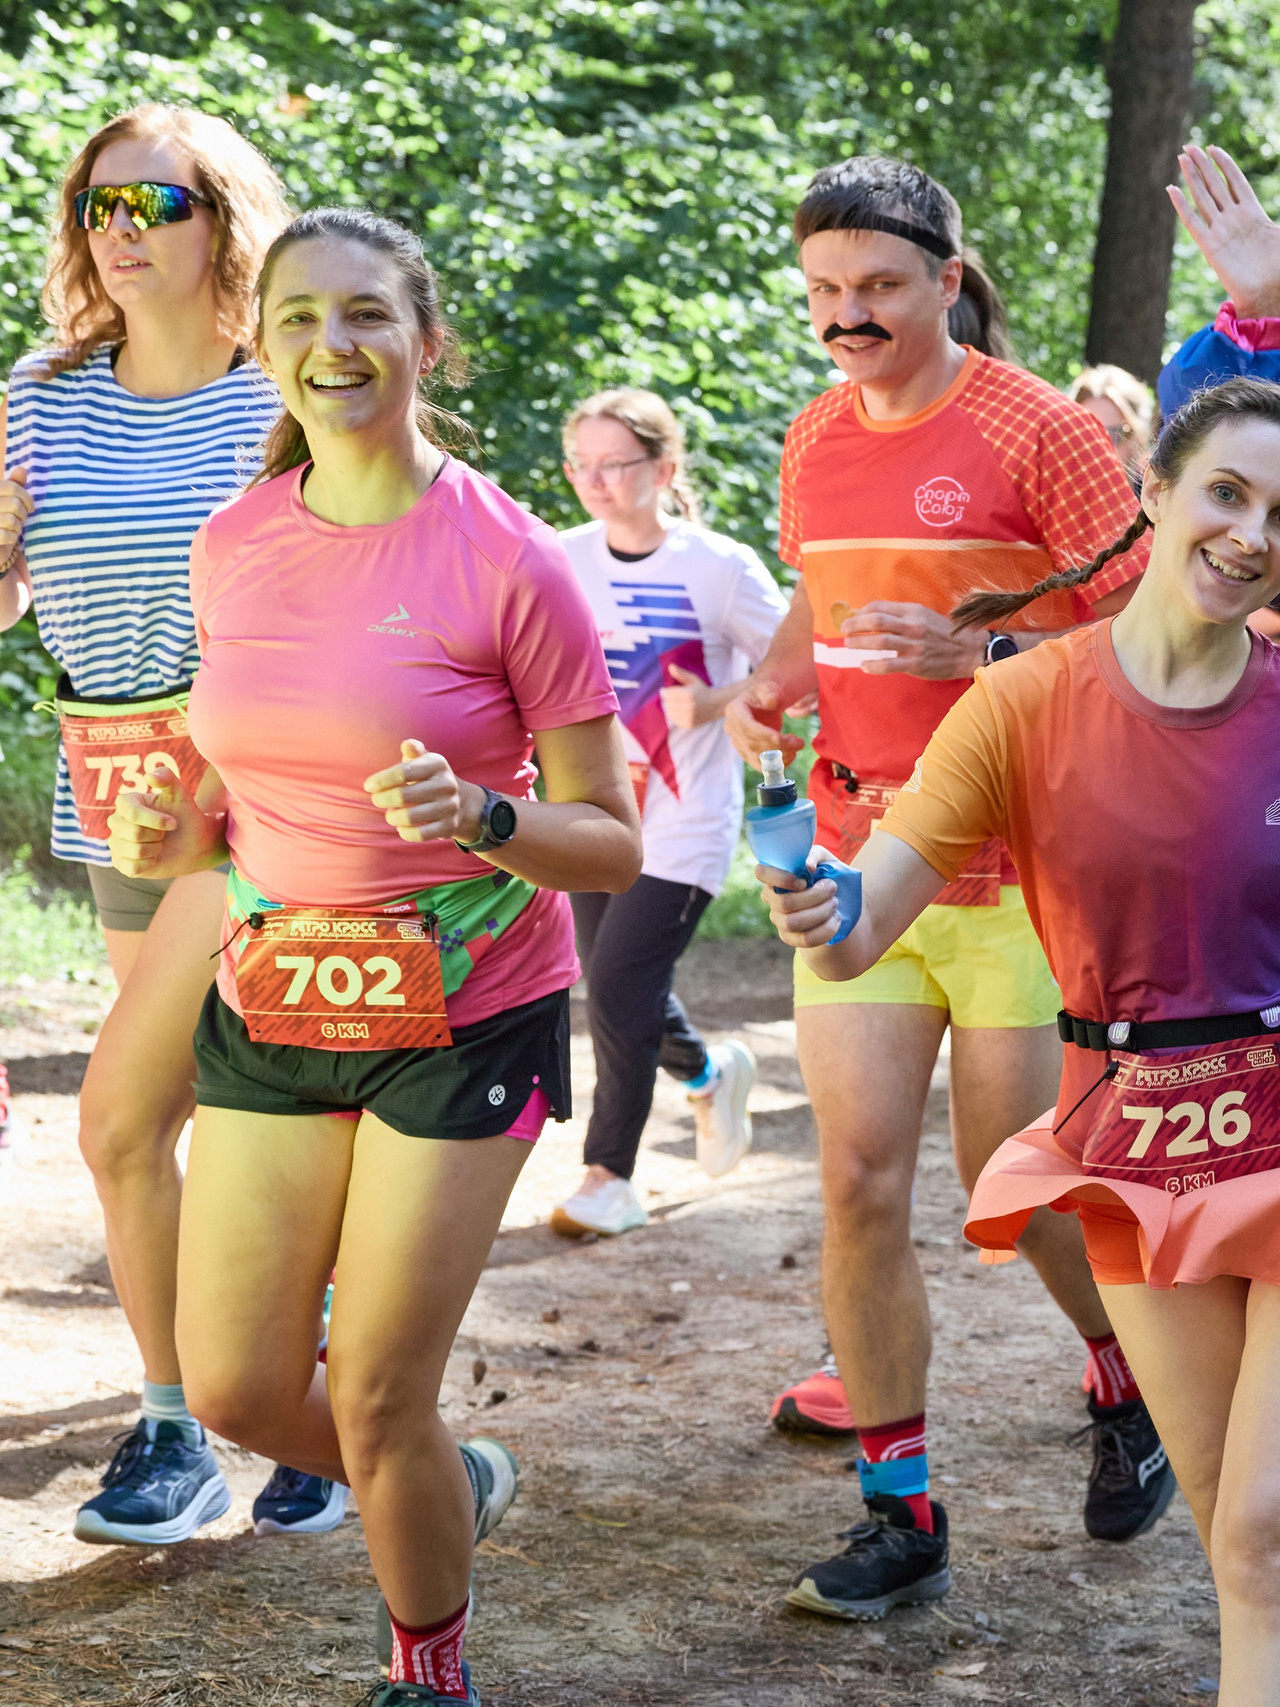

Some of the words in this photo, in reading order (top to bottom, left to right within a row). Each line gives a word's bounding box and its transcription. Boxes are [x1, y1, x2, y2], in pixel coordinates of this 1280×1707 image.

[366, 624, 419, 639] DEMIX
[291, 920, 331, 933] РЕТРО
[332, 921, 377, 934] КРОСС
[275, 955, 406, 1006] 702
[321, 1022, 335, 1038] 6
[1247, 1049, 1273, 1061] СПОРТ
[1252, 1057, 1276, 1068] СОЮЗ
[1137, 1068, 1179, 1082] РЕТРО
[1182, 1056, 1226, 1077] КРОСС
[1122, 1091, 1251, 1159] 726
[1165, 1177, 1180, 1194] 6
